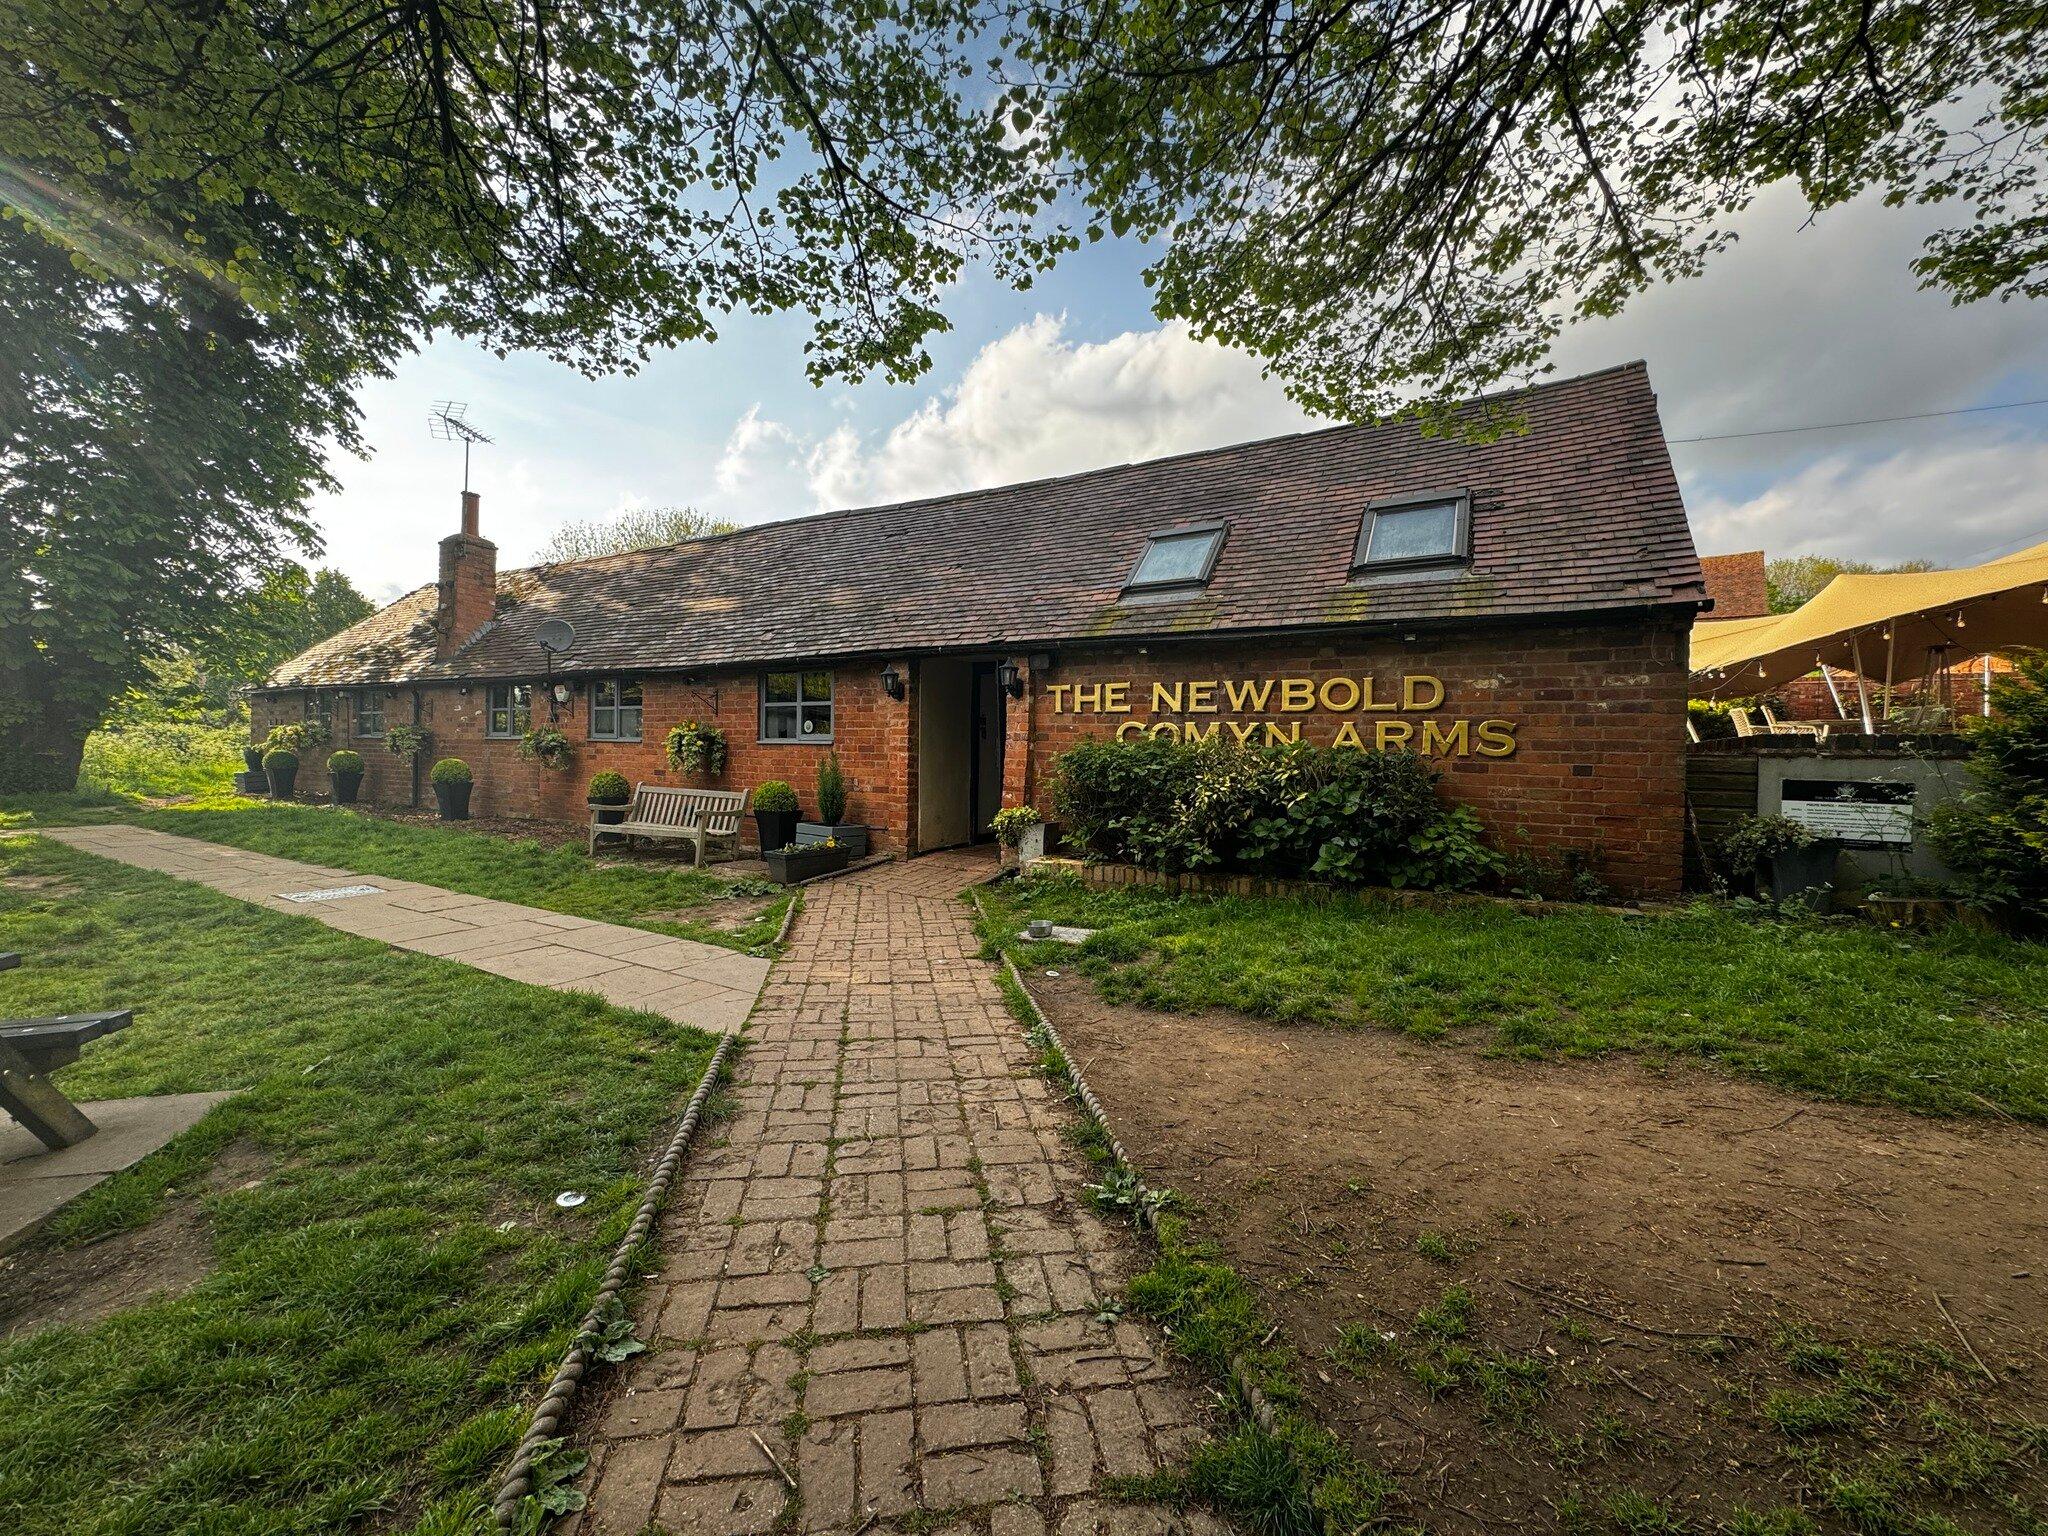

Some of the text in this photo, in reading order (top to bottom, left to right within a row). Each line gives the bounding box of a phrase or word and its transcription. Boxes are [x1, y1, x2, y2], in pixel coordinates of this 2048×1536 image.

[1046, 675, 1445, 714] THE NEWBOLD
[1115, 719, 1517, 757] COMYN ARMS
